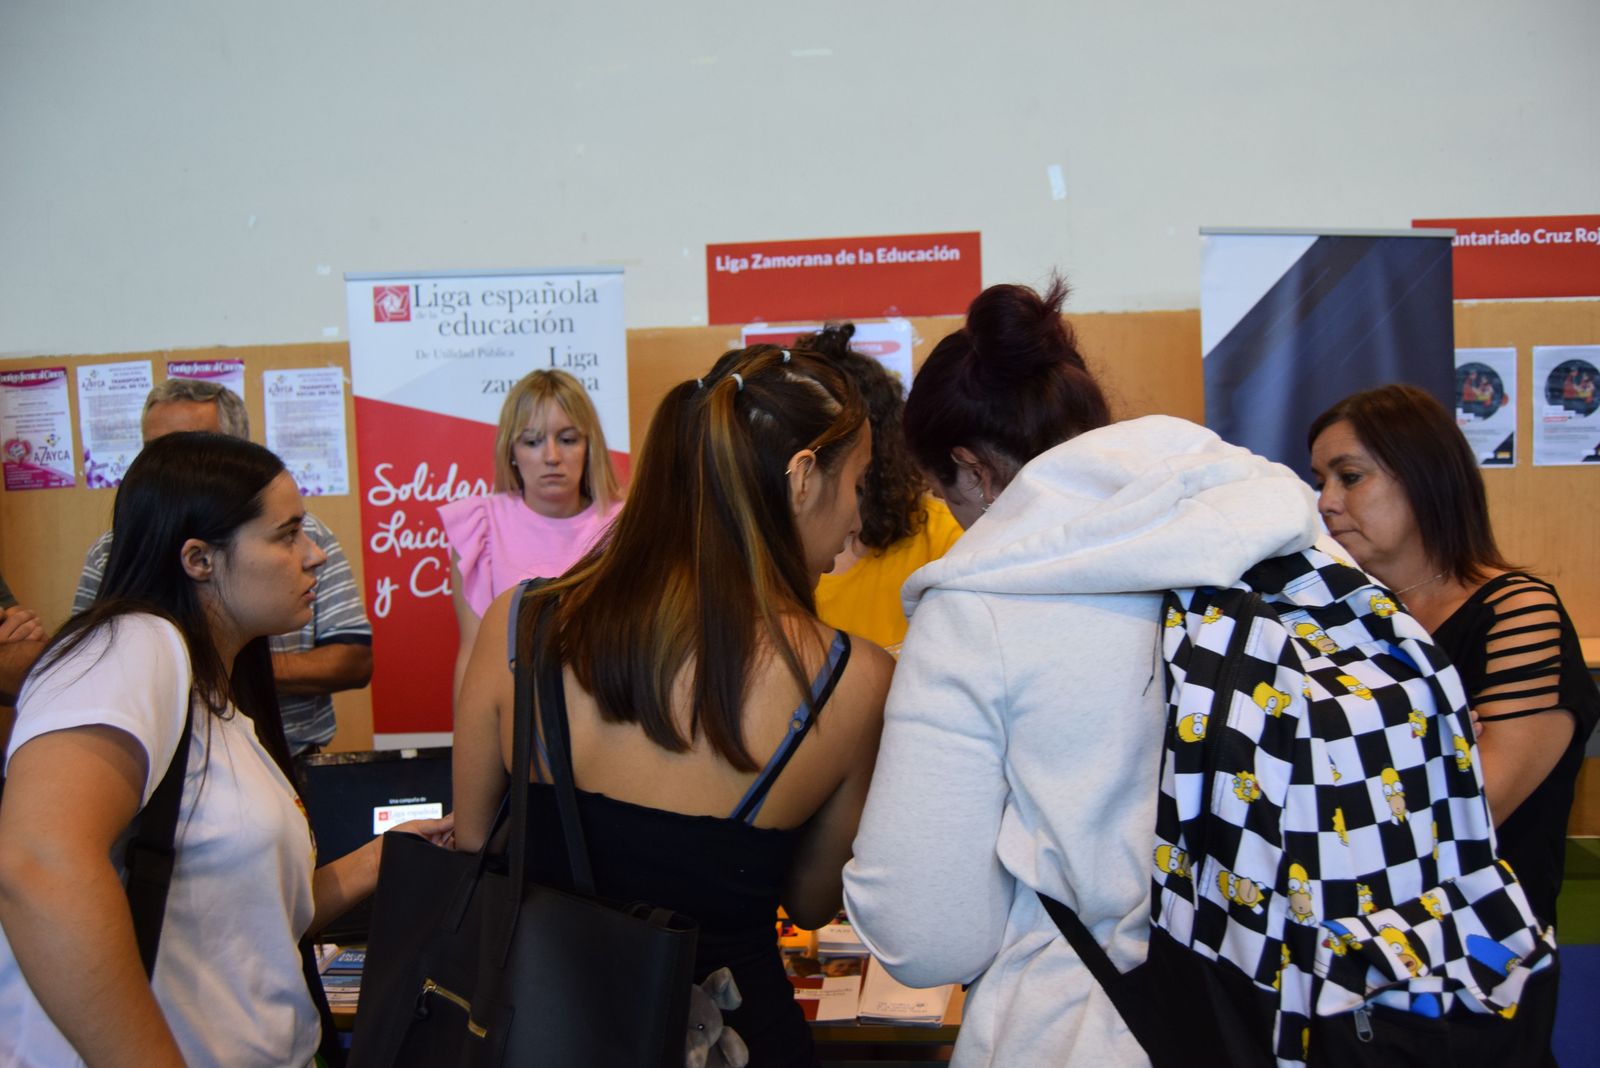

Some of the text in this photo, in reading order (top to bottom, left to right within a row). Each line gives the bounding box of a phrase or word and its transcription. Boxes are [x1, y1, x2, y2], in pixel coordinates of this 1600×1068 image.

[1452, 227, 1600, 247] untariado Cruz Roj
[716, 244, 960, 274] Liga Zamorana de la Educación
[413, 280, 599, 314] Liga española
[415, 311, 428, 320] de
[438, 309, 575, 337] educación
[415, 346, 515, 360] De Utilidad Pública
[548, 346, 600, 371] Liga
[34, 446, 70, 466] AZAYCA
[368, 462, 494, 506] Solidar
[374, 576, 399, 618] y
